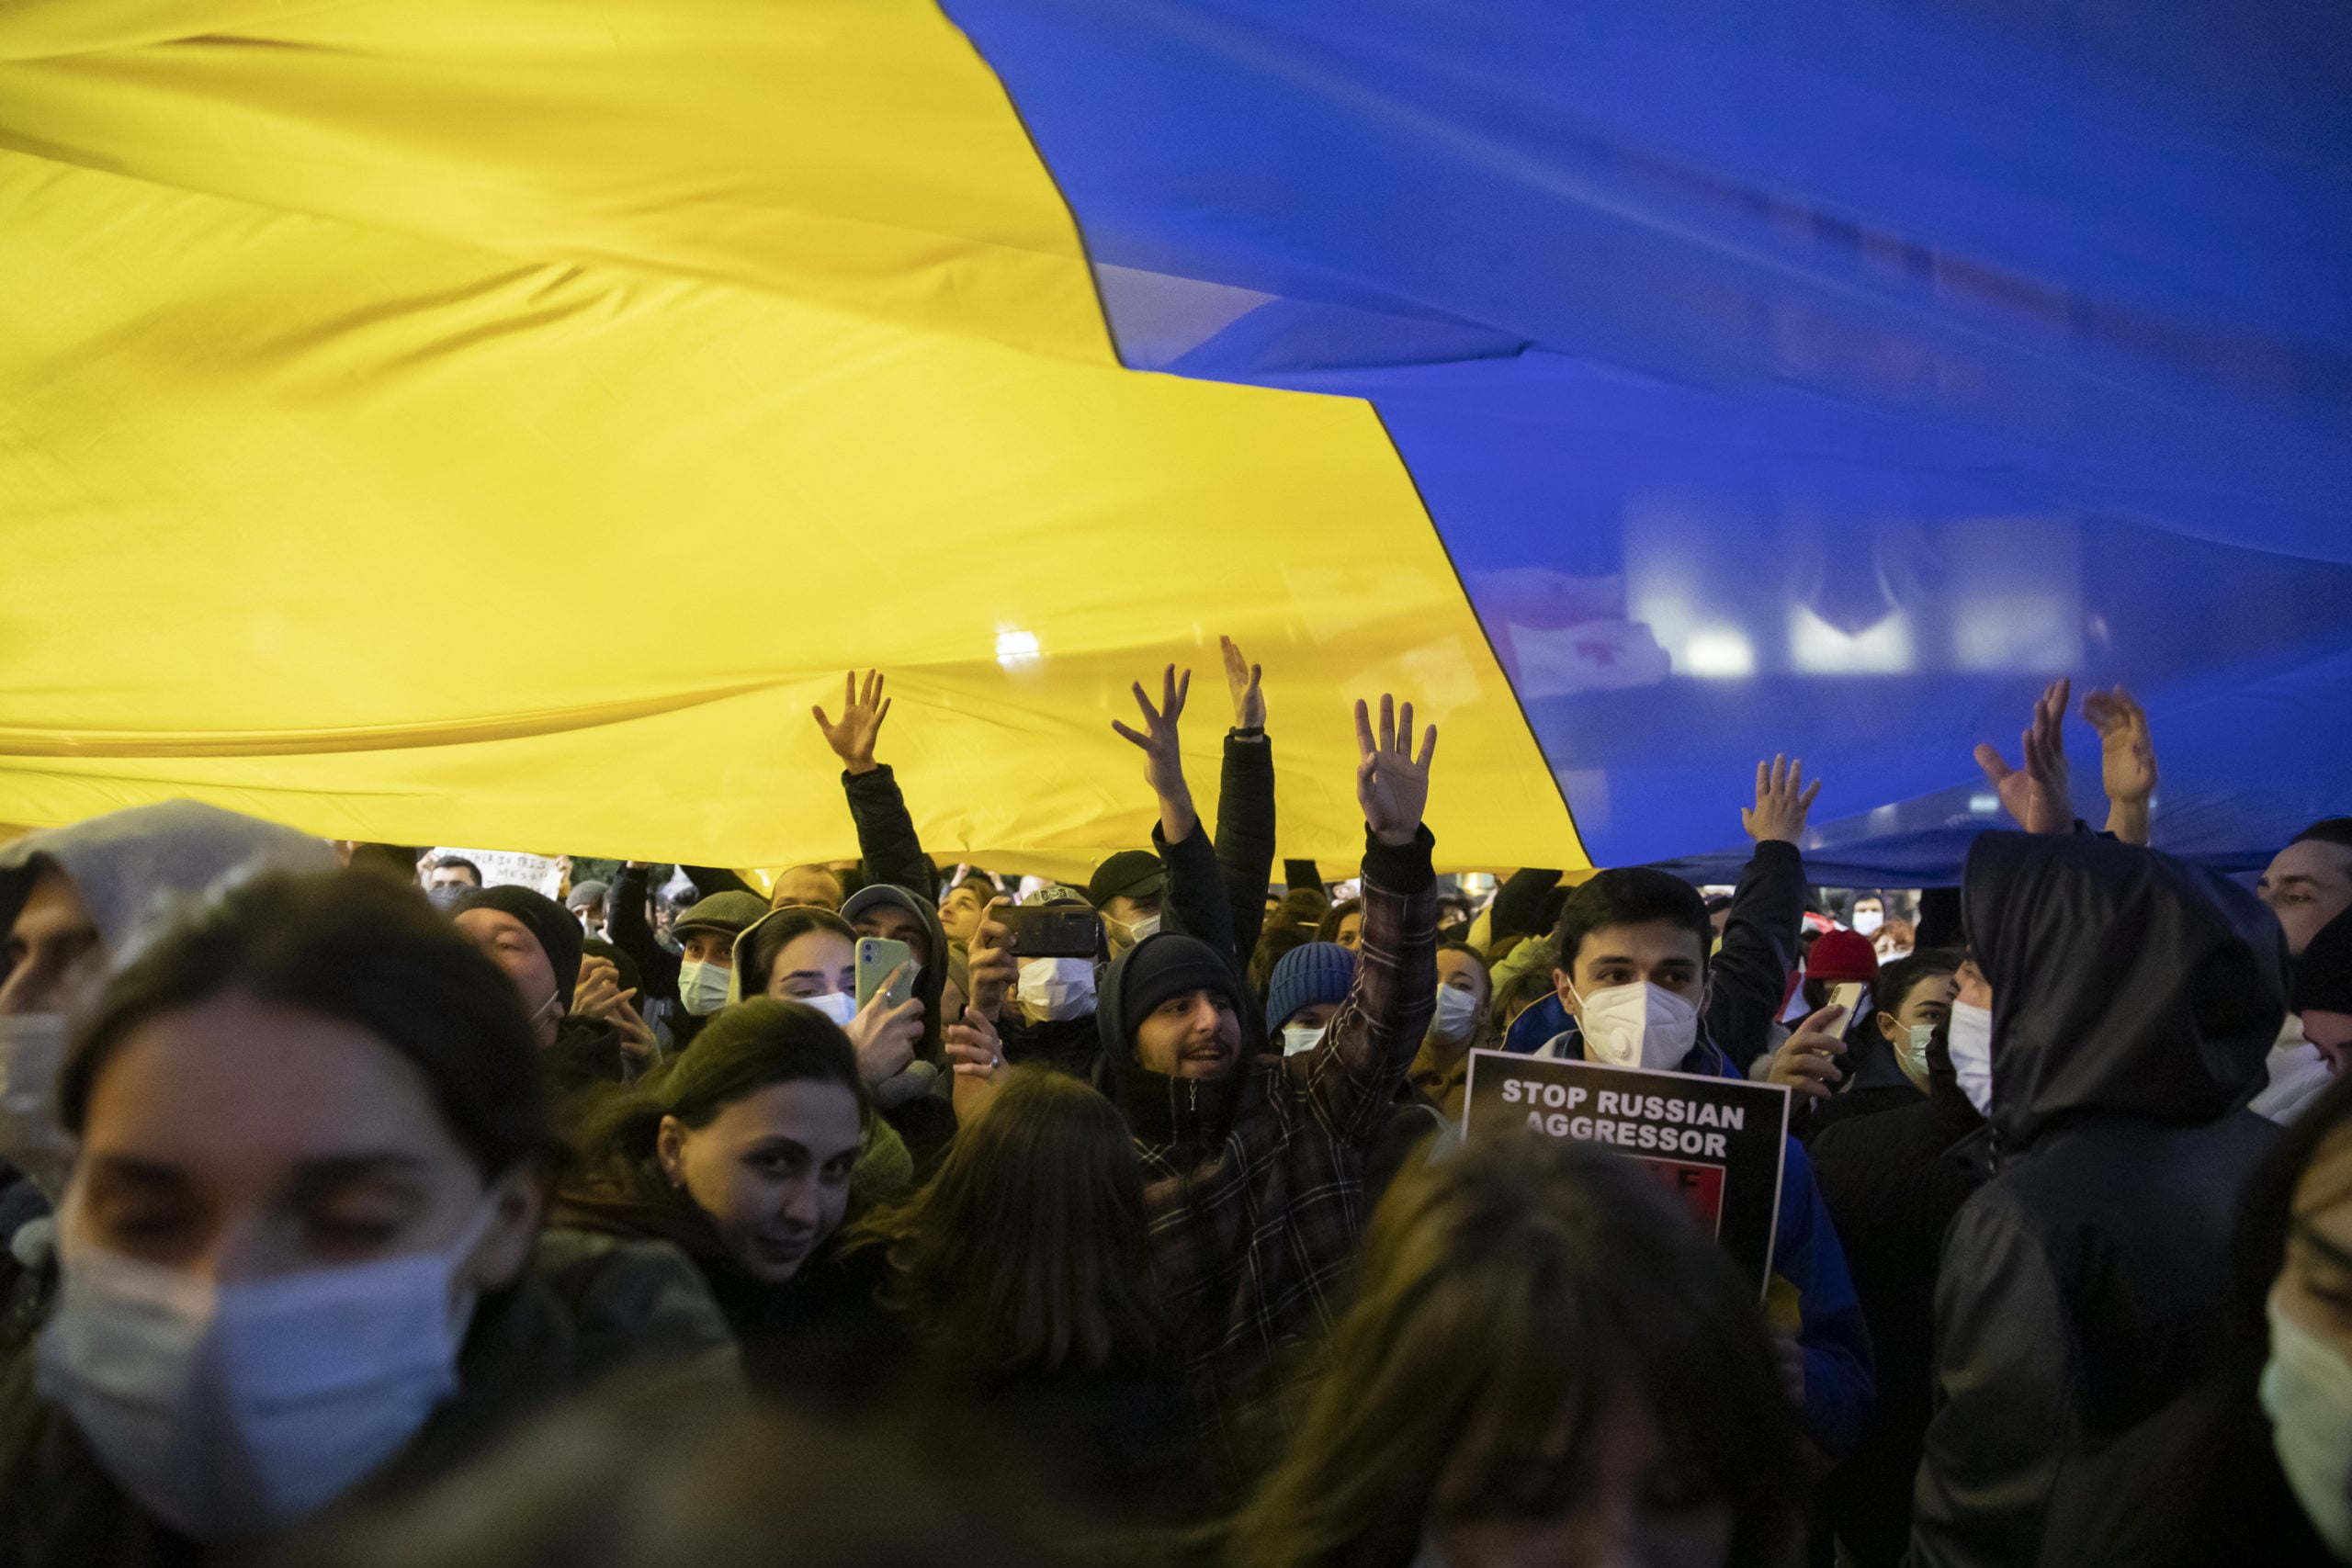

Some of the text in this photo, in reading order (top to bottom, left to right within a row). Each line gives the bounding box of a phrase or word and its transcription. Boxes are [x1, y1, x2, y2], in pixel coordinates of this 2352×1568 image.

[1501, 1078, 1745, 1131] STOP RUSSIAN
[1526, 1111, 1727, 1158] AGGRESSOR
